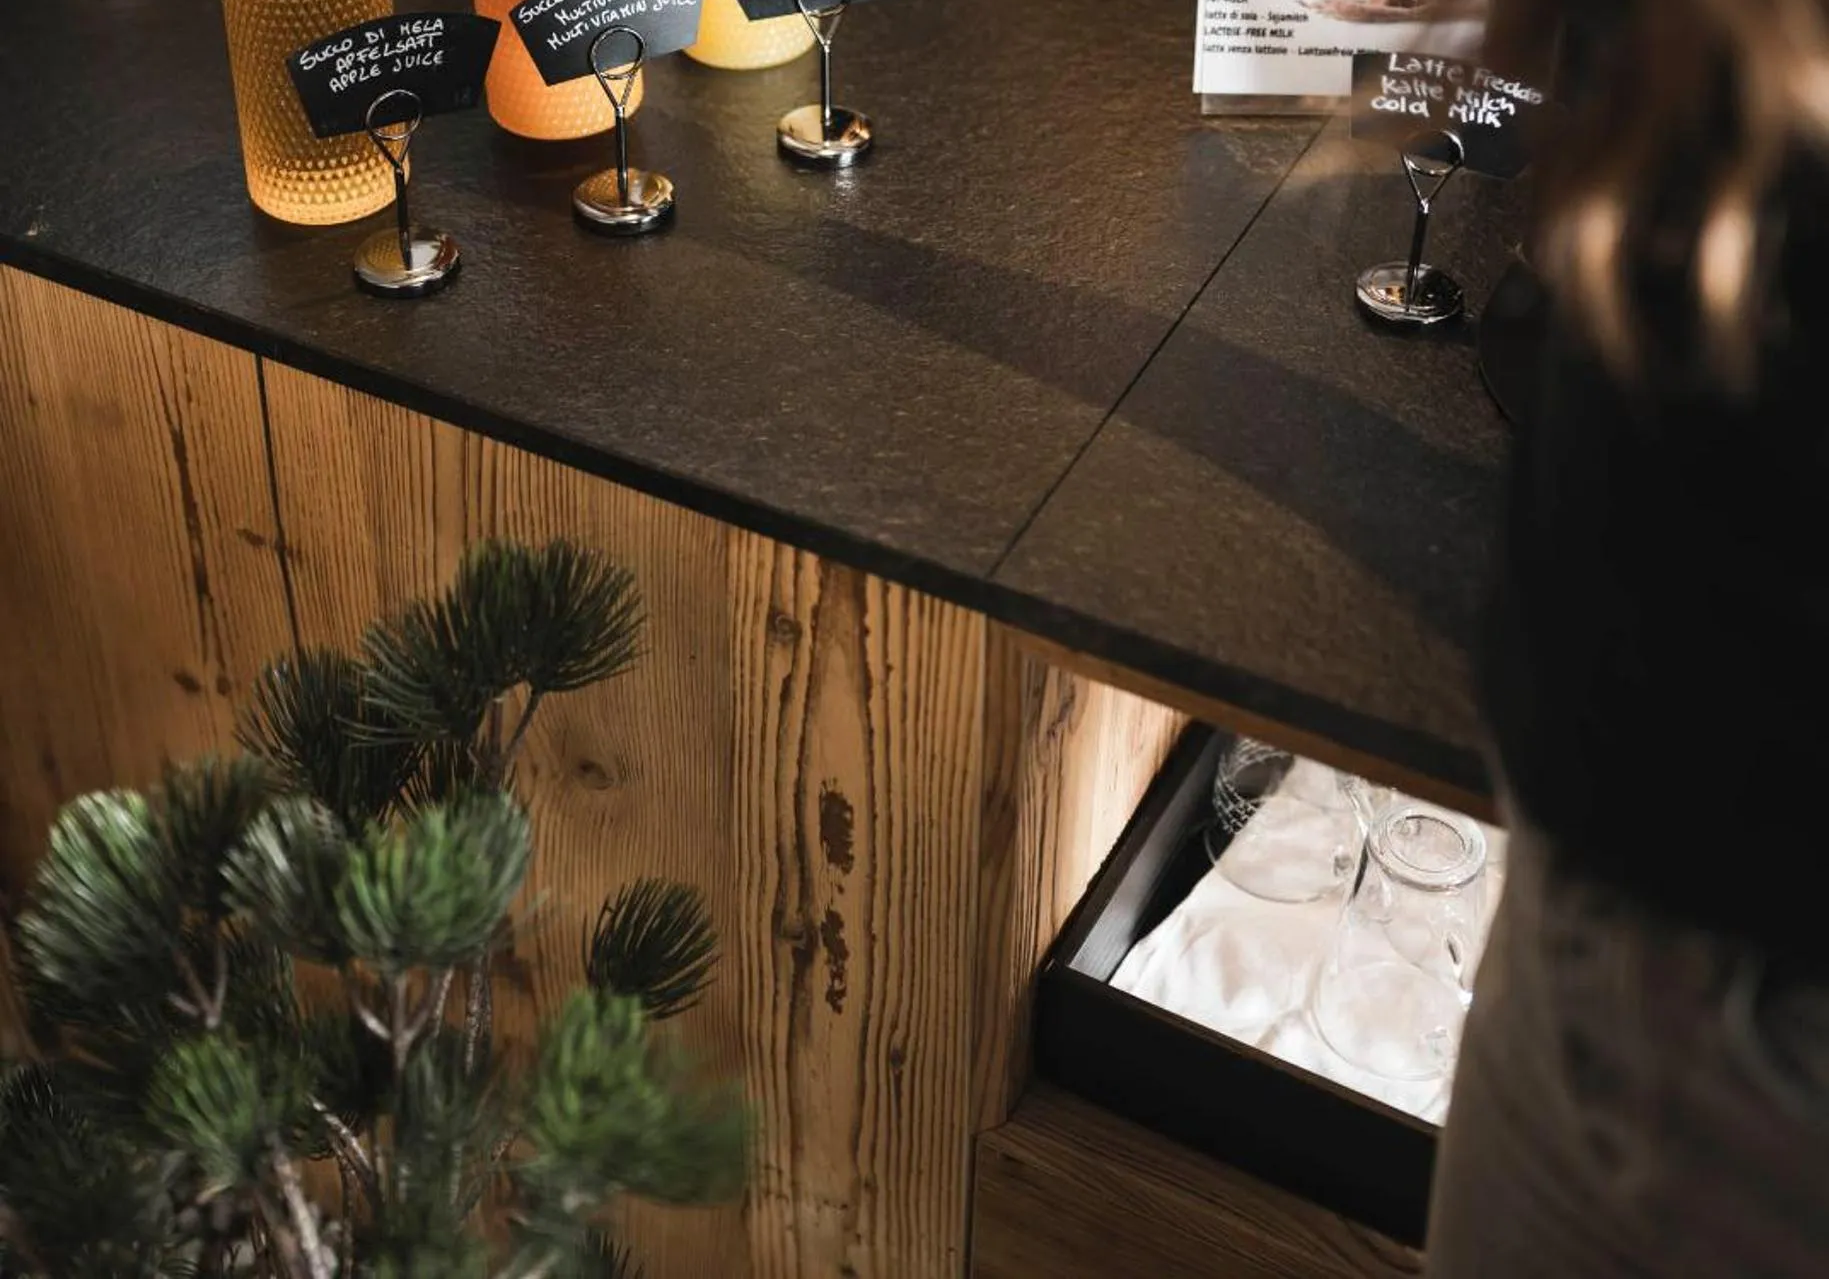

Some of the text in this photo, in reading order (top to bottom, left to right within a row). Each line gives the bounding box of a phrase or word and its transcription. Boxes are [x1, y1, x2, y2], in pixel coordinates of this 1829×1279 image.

[300, 18, 444, 70] SUCCO DI MELA
[547, 0, 647, 51] MULTIVITAMIN
[1269, 27, 1294, 38] MILK
[329, 51, 444, 93] APPLE JUICE
[335, 32, 442, 73] APFELSAFT
[1381, 75, 1515, 116] Kalte Milch
[1388, 53, 1543, 105] Latte Freddo
[1448, 102, 1501, 128] Milk
